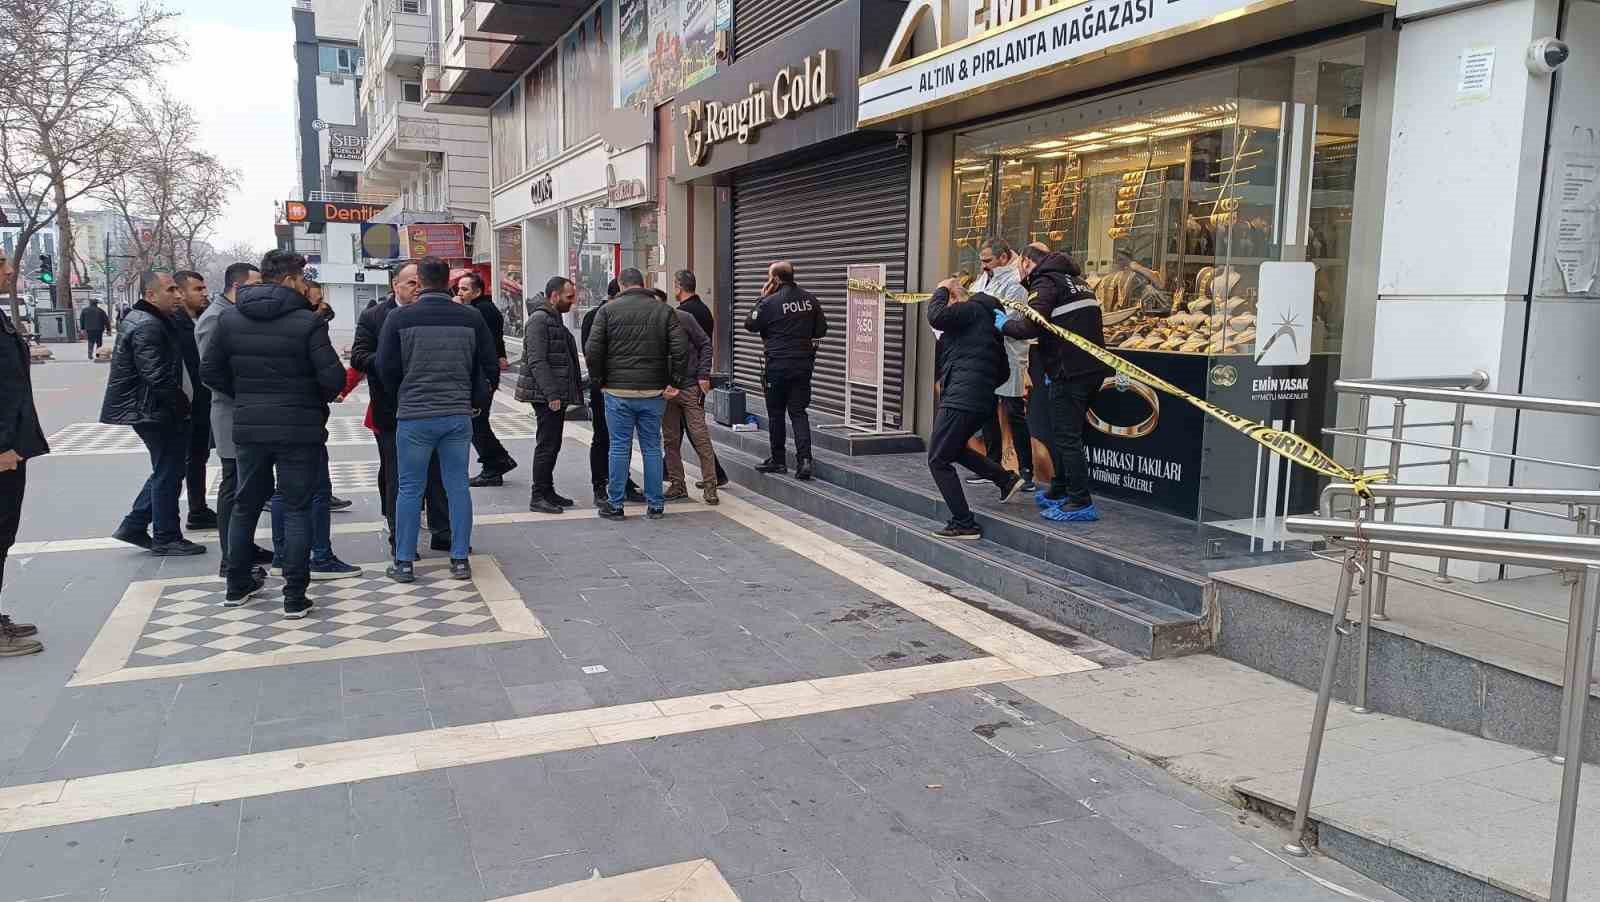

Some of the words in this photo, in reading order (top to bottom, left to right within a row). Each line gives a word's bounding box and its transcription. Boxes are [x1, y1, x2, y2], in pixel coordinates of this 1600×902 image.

[919, 63, 954, 92] ALTIN
[958, 59, 968, 80] &
[972, 31, 1047, 76] PIRLANTA
[1052, 0, 1153, 49] MAĞAZASI
[705, 82, 768, 144] Rengin
[772, 49, 827, 119] Gold
[1252, 376, 1278, 391] EMİN
[1279, 378, 1309, 391] YASAK
[1092, 447, 1135, 472] MARKASI
[1137, 455, 1182, 481] TAKILARI
[1122, 473, 1153, 493] SİZLERLE
